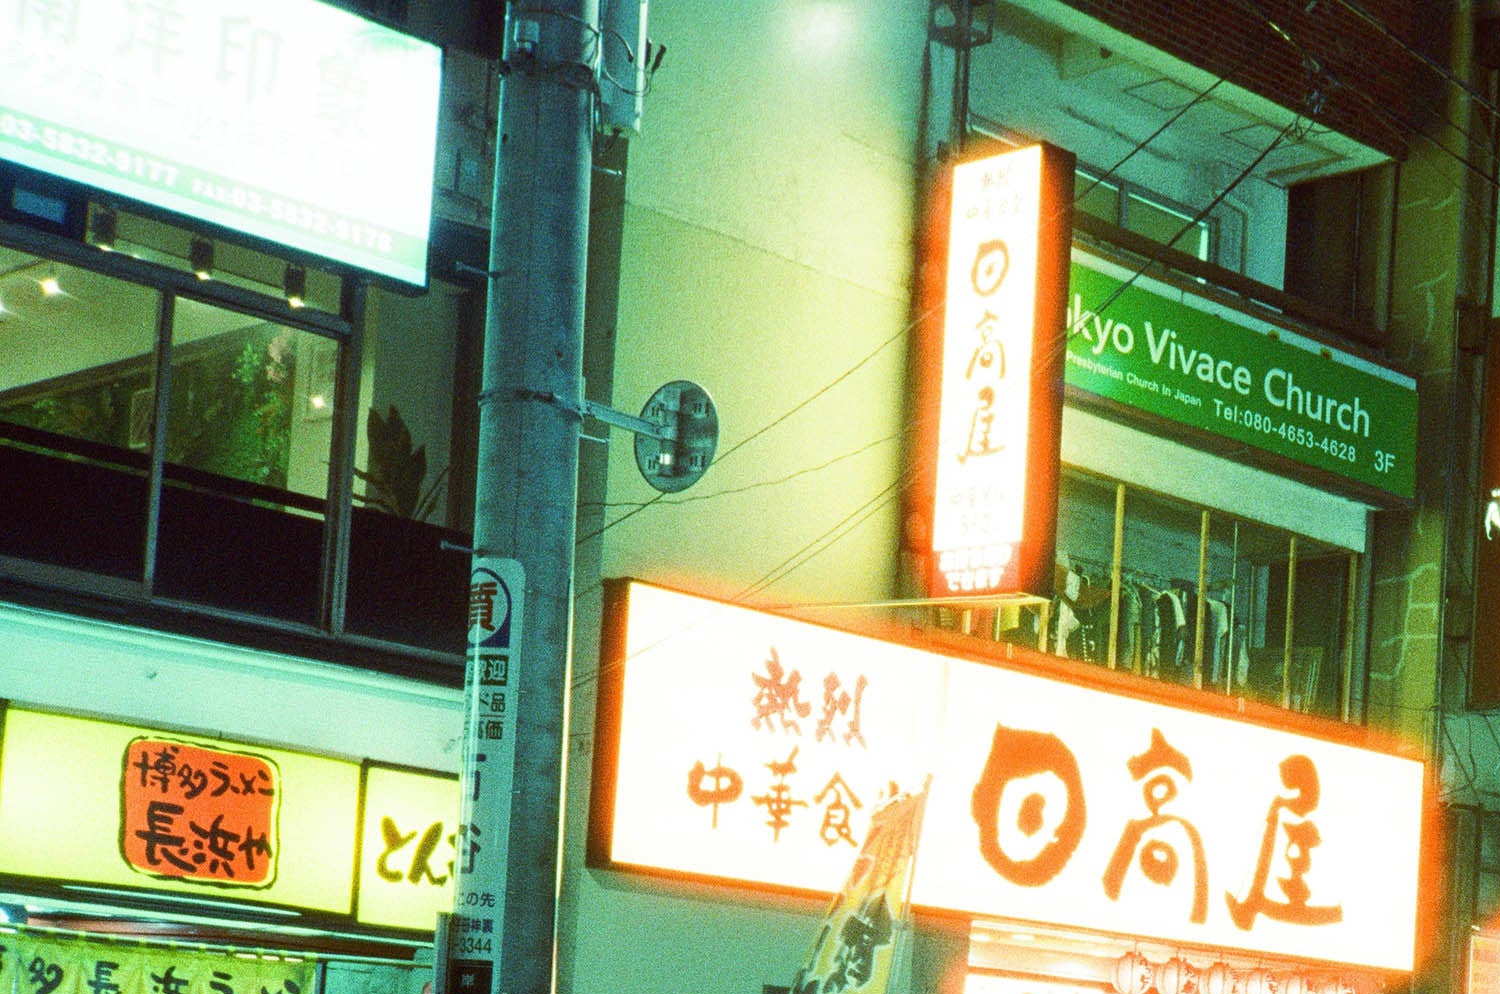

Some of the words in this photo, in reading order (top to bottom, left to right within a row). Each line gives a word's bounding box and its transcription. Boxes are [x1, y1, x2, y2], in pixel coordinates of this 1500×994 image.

[957, 238, 1011, 466] 日高屋
[1066, 292, 1134, 355] kyo
[1144, 320, 1252, 395] Vivace
[1264, 366, 1370, 438] Church
[1126, 372, 1160, 393] Church
[1173, 388, 1203, 409] Japan
[1373, 449, 1396, 474] 3F
[750, 646, 870, 748] 熱烈
[135, 800, 273, 878] 長浜や
[687, 747, 905, 849] 中華食
[971, 721, 1344, 931] 日高屋
